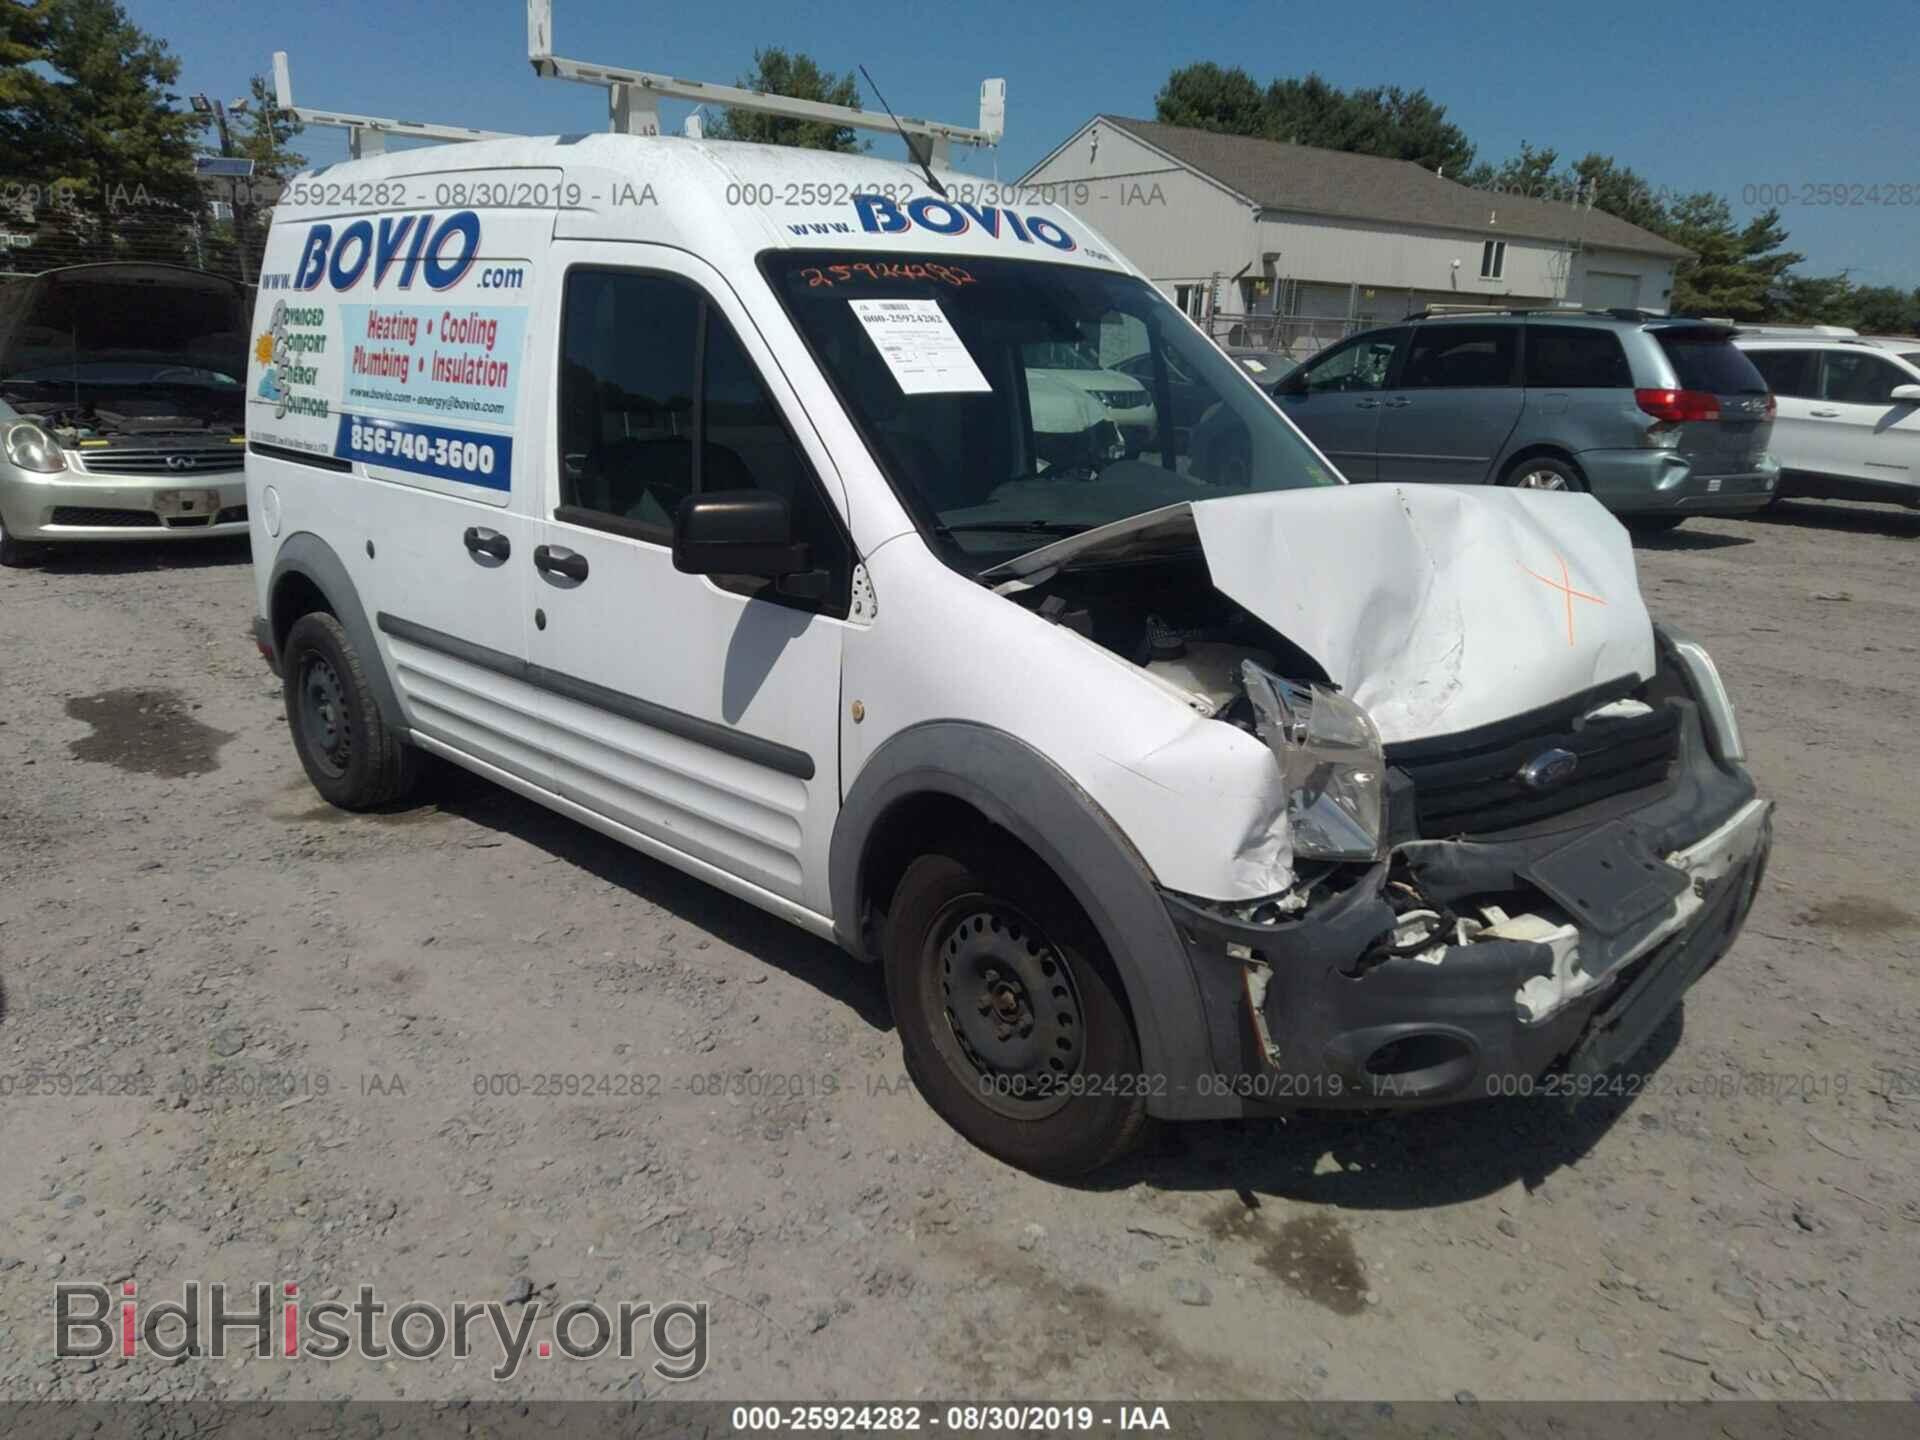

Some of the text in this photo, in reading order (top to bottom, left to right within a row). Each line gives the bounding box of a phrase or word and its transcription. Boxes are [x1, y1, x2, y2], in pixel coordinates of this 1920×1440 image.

[367, 310, 498, 351] Heating Cooling
[352, 345, 509, 388] Plumbing Insulation
[351, 424, 496, 474] 856-740-3600
